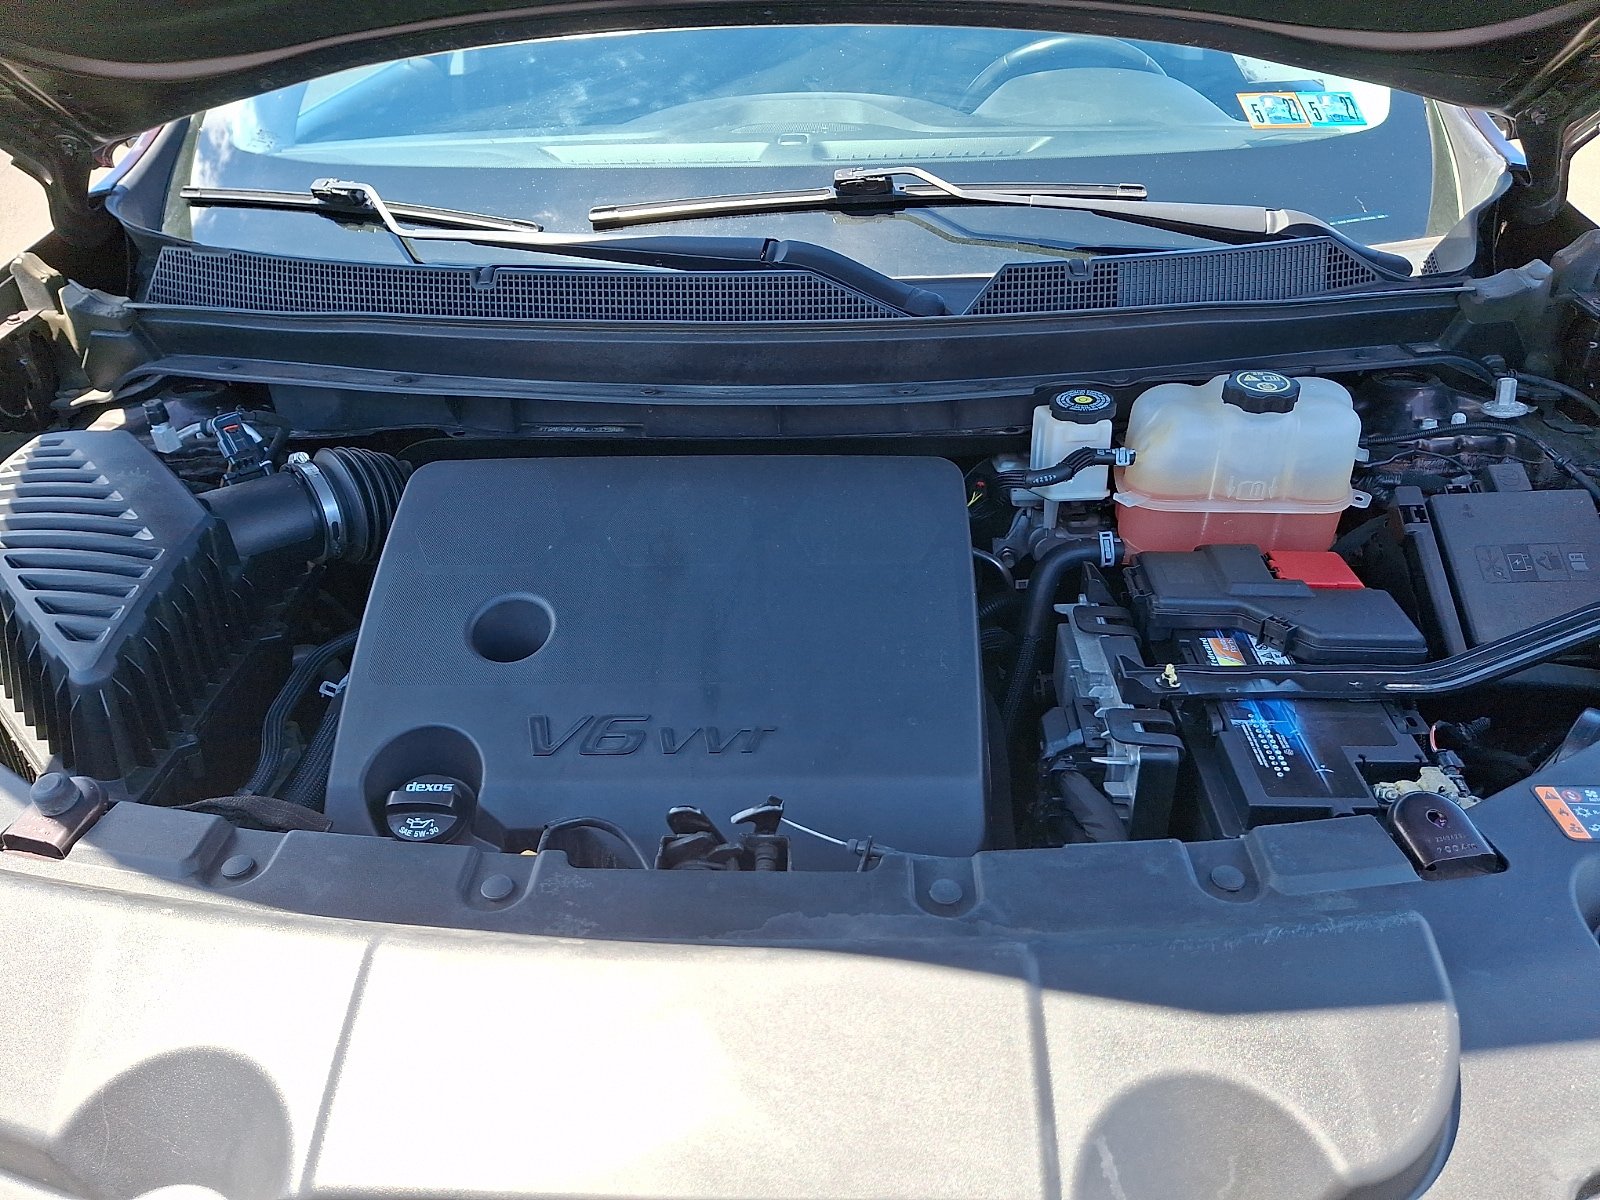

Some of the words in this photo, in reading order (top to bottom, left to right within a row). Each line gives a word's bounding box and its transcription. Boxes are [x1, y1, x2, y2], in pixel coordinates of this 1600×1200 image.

[1251, 103, 1265, 123] 5
[1282, 97, 1302, 121] 27
[1308, 101, 1322, 121] 5
[1339, 96, 1360, 120] 27
[528, 714, 650, 756] V6
[659, 727, 777, 754] VVT
[405, 782, 454, 792] dexos
[399, 826, 412, 837] SAE
[413, 826, 439, 838] 5W-30
